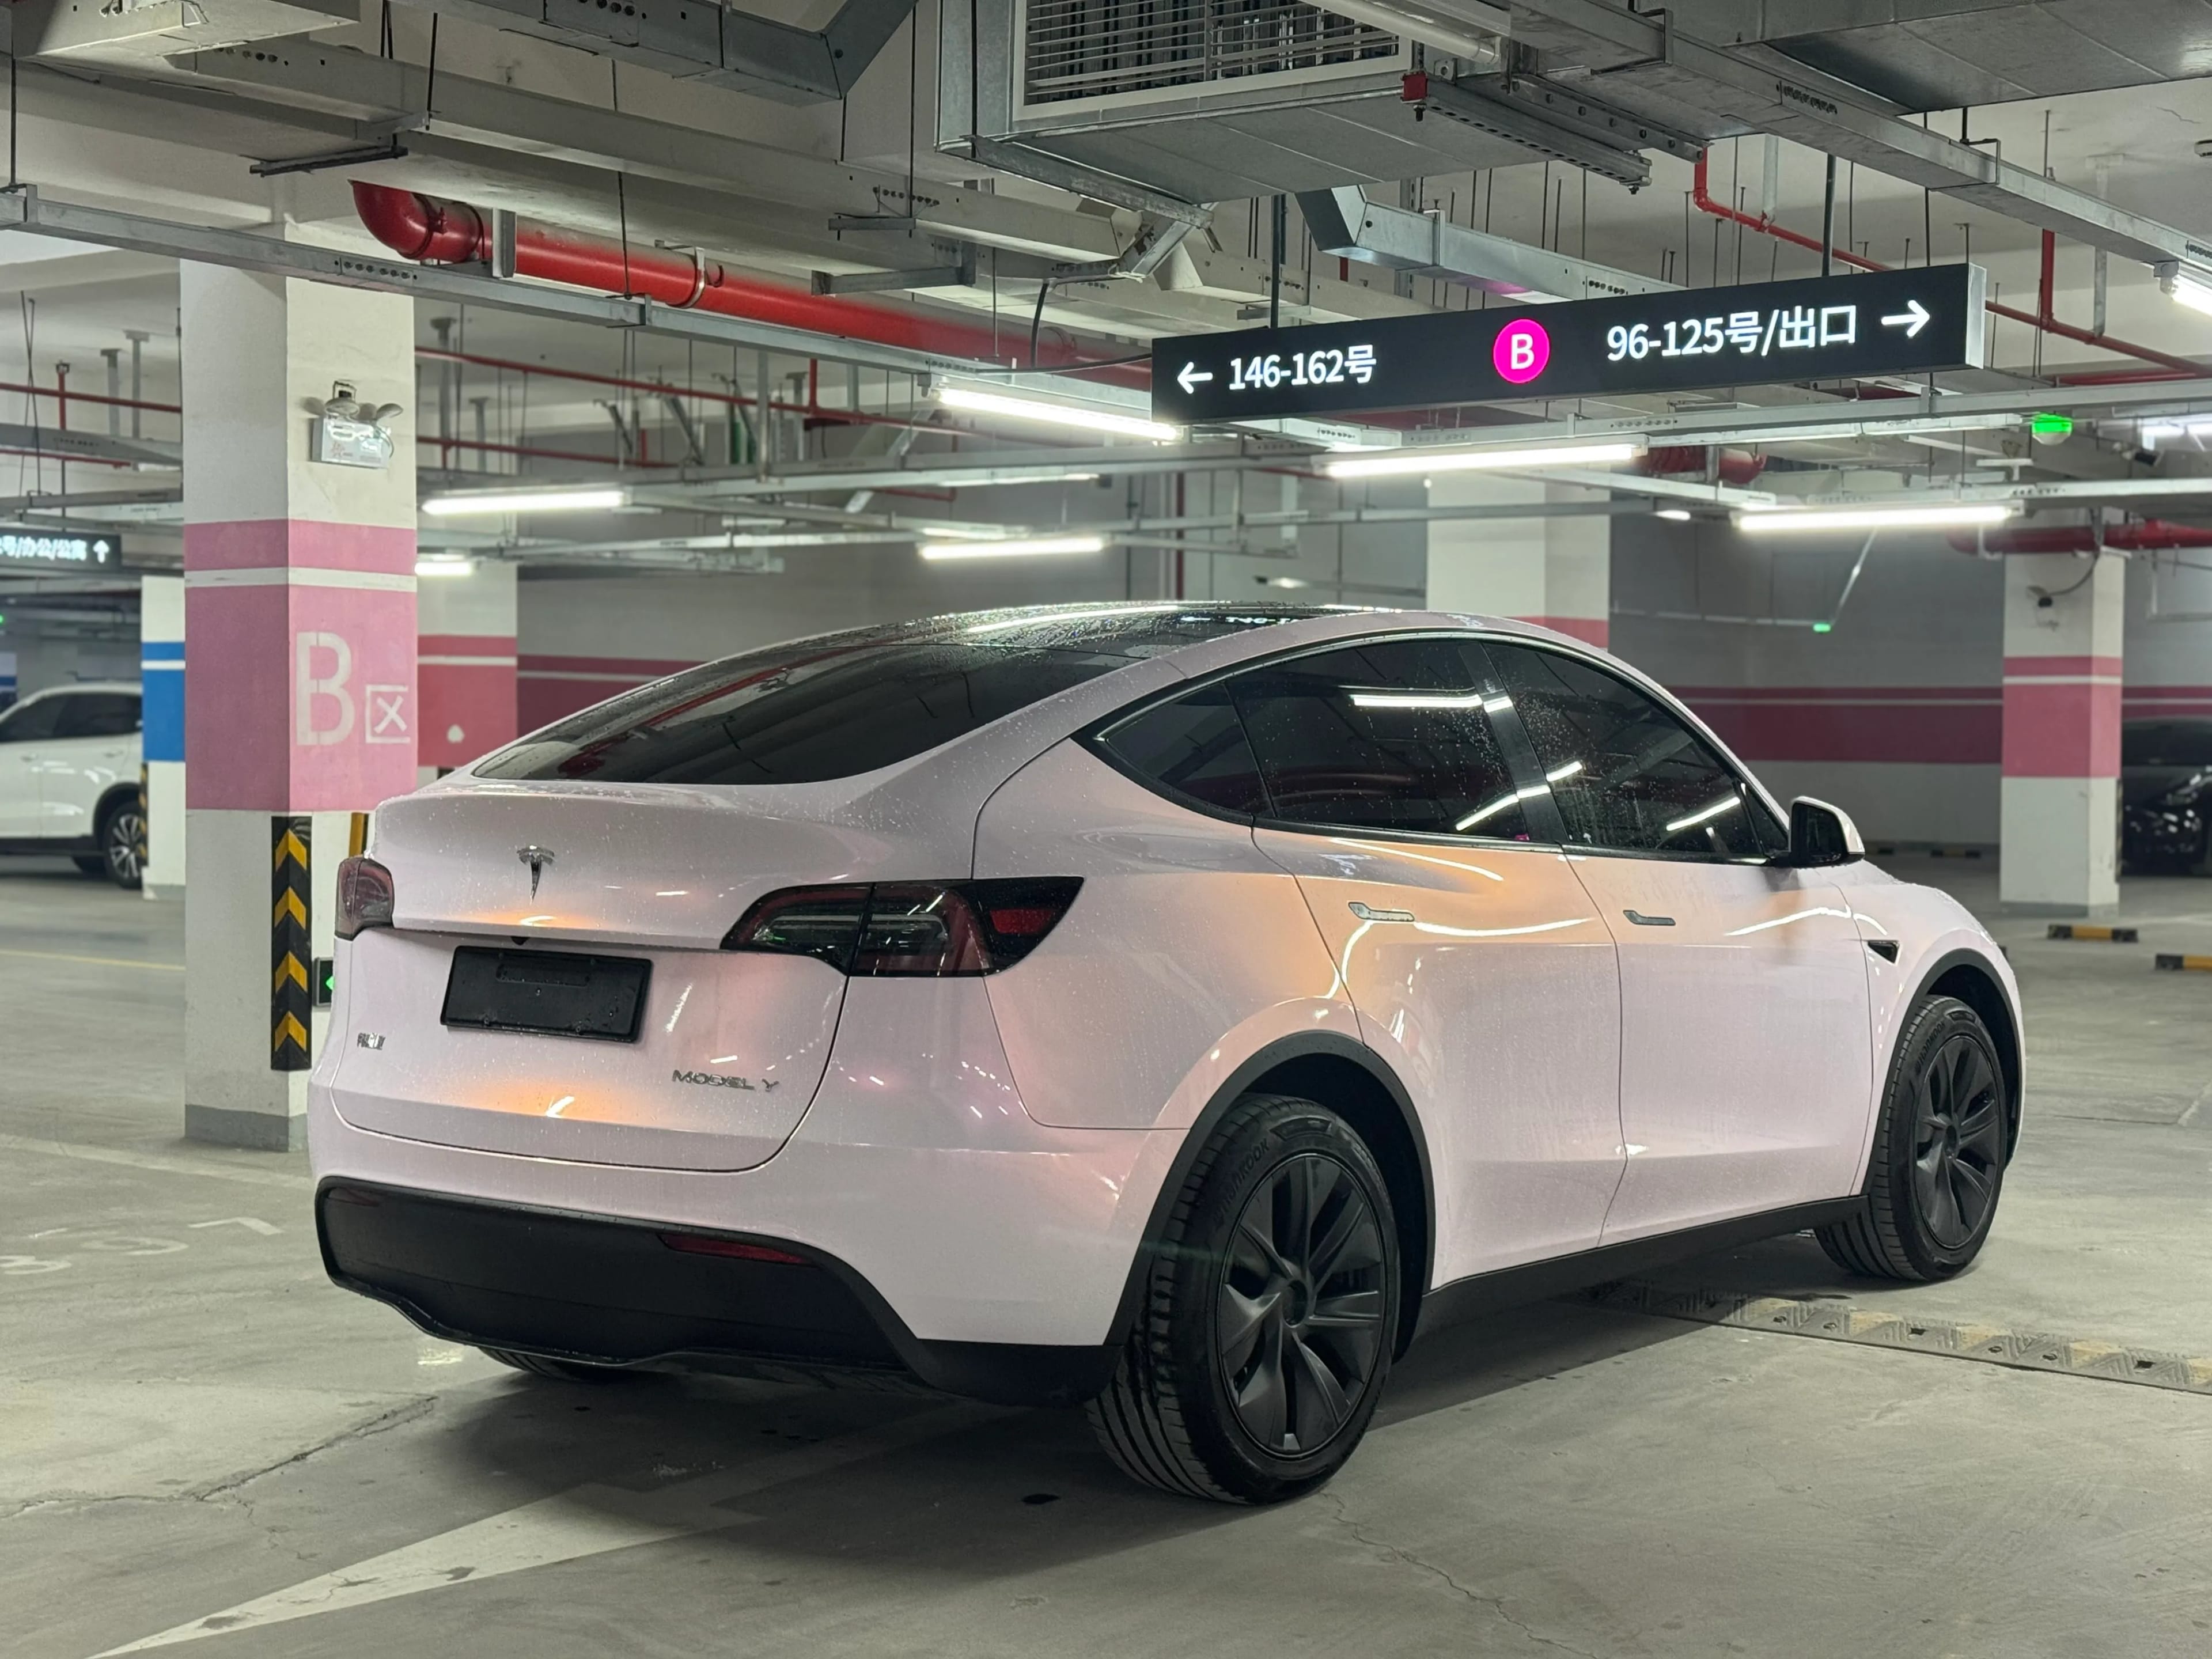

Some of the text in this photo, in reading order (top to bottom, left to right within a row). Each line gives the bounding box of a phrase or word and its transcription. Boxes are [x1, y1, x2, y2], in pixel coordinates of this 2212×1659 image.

[1511, 333, 1535, 370] B
[1607, 305, 1857, 362] 96-125号/出口
[1229, 344, 1377, 390] 146-162号
[672, 1070, 780, 1092] MODEL Y
